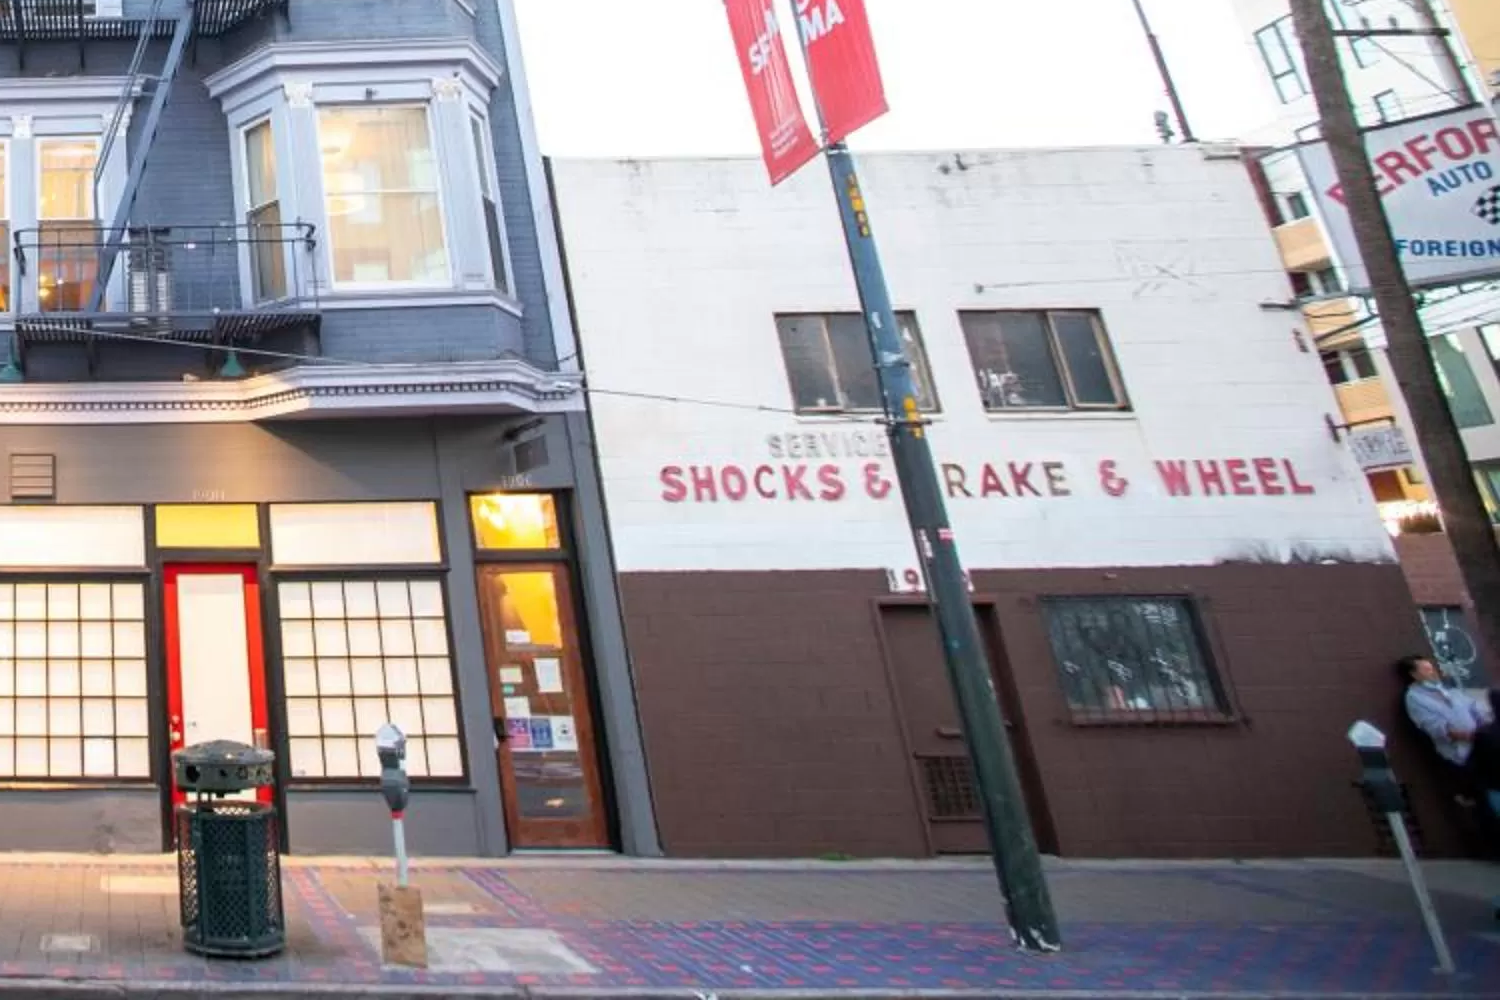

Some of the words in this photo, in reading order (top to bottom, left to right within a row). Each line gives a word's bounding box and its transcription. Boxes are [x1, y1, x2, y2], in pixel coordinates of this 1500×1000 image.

[1426, 161, 1492, 196] AUTO
[1395, 238, 1500, 257] FOREIGN
[769, 433, 890, 458] SERVICE
[660, 464, 846, 503] SHOCKS
[864, 462, 892, 500] &
[940, 462, 1071, 498] RAKE
[1098, 459, 1128, 497] &
[1153, 457, 1316, 497] WHEEL
